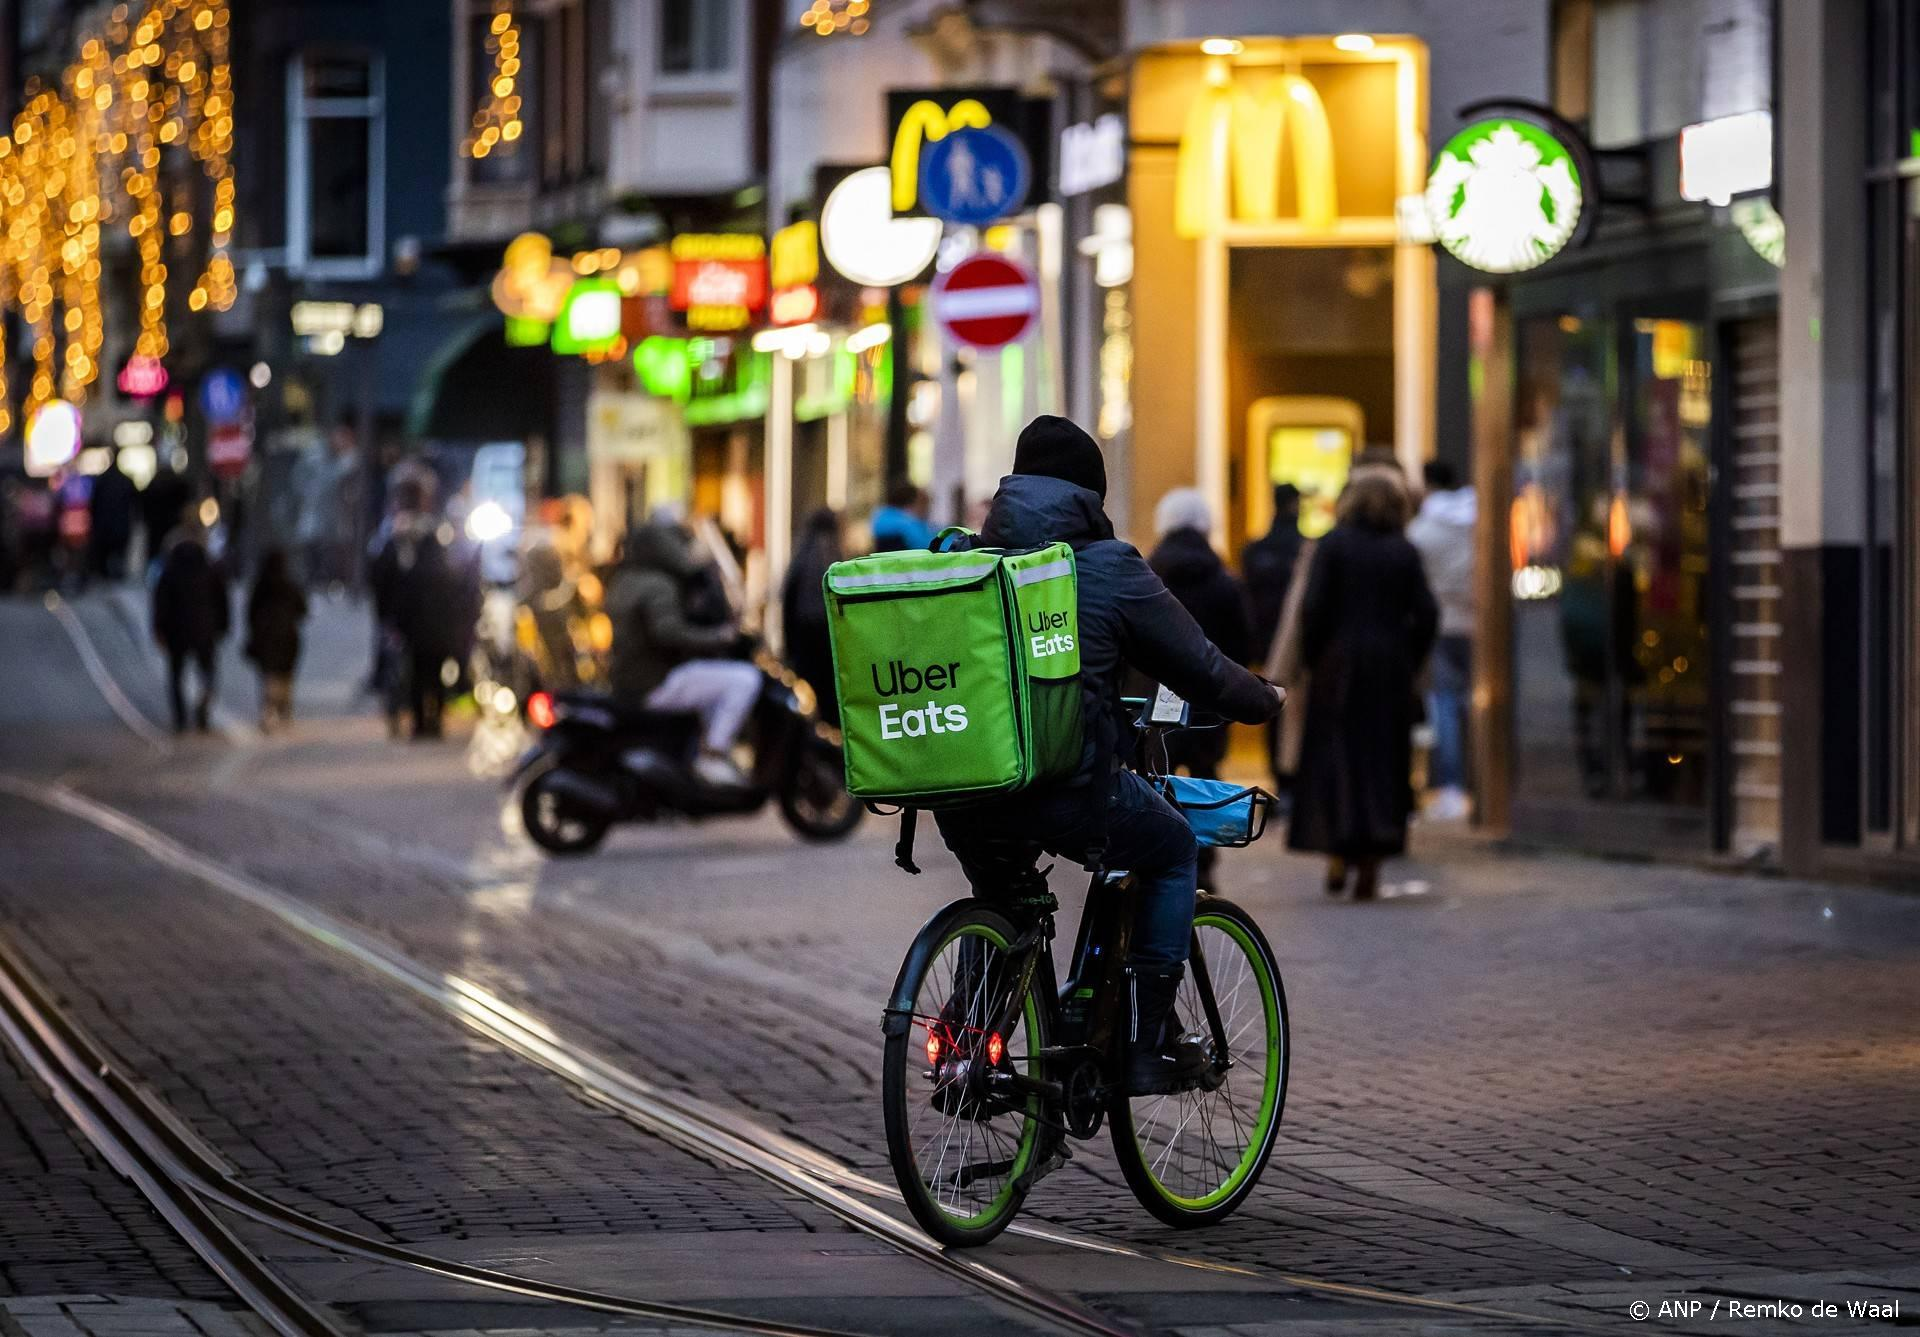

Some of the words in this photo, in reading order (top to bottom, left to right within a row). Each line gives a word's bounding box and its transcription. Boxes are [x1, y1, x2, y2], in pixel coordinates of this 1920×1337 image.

[1028, 611, 1068, 633] Uber
[1031, 633, 1075, 658] Eats
[871, 660, 961, 697] Uber
[878, 701, 969, 740] Eats
